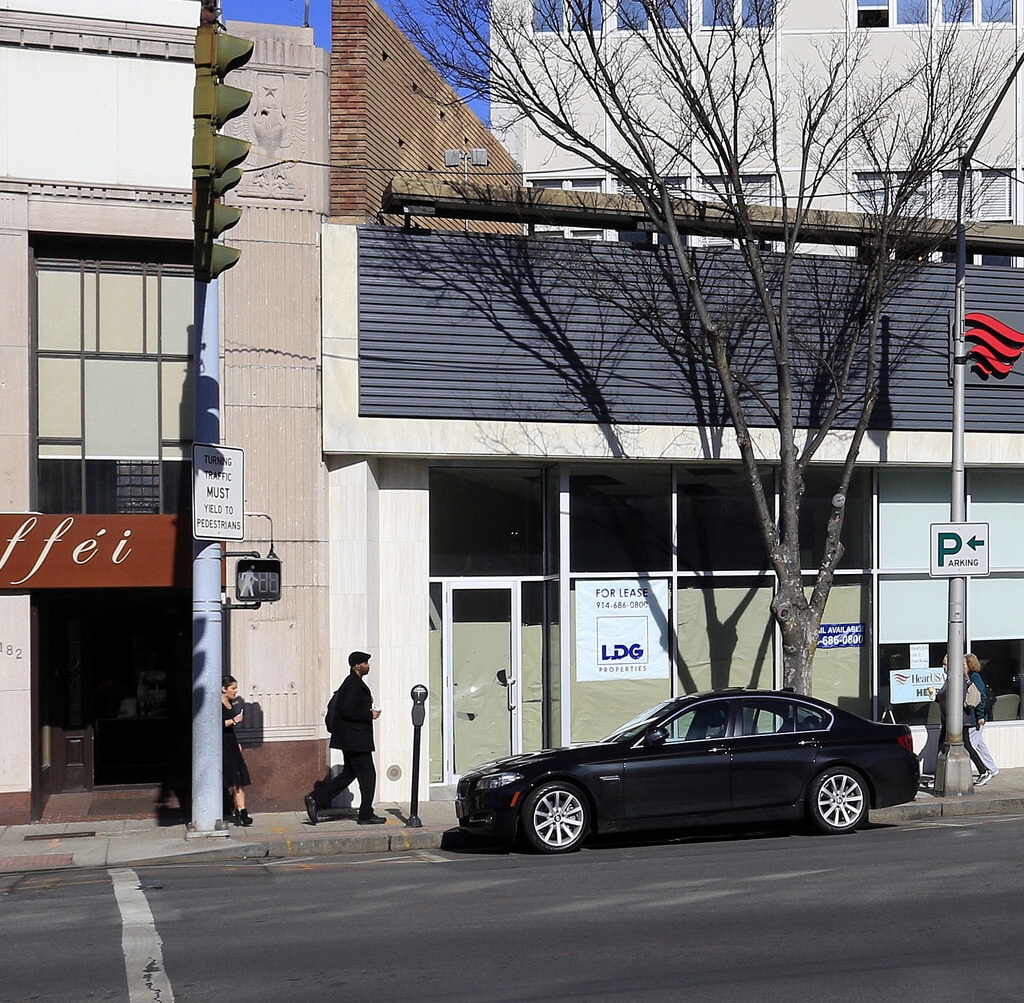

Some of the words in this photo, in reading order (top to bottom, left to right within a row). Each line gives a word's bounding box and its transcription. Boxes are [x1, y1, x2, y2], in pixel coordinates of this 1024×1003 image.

[204, 455, 232, 467] TURNING
[204, 471, 232, 482] TRAFFIC
[206, 486, 230, 499] MUST
[204, 504, 222, 514] YIELD
[225, 505, 234, 515] TO
[196, 518, 241, 530] PEDESTRIANS
[595, 588, 616, 598] FOR
[619, 588, 649, 598] LEASE
[595, 601, 649, 609] 914-686-0800
[828, 625, 864, 634] AVAILABLE
[601, 643, 644, 661] LDG
[598, 665, 647, 673] PROPERTIES
